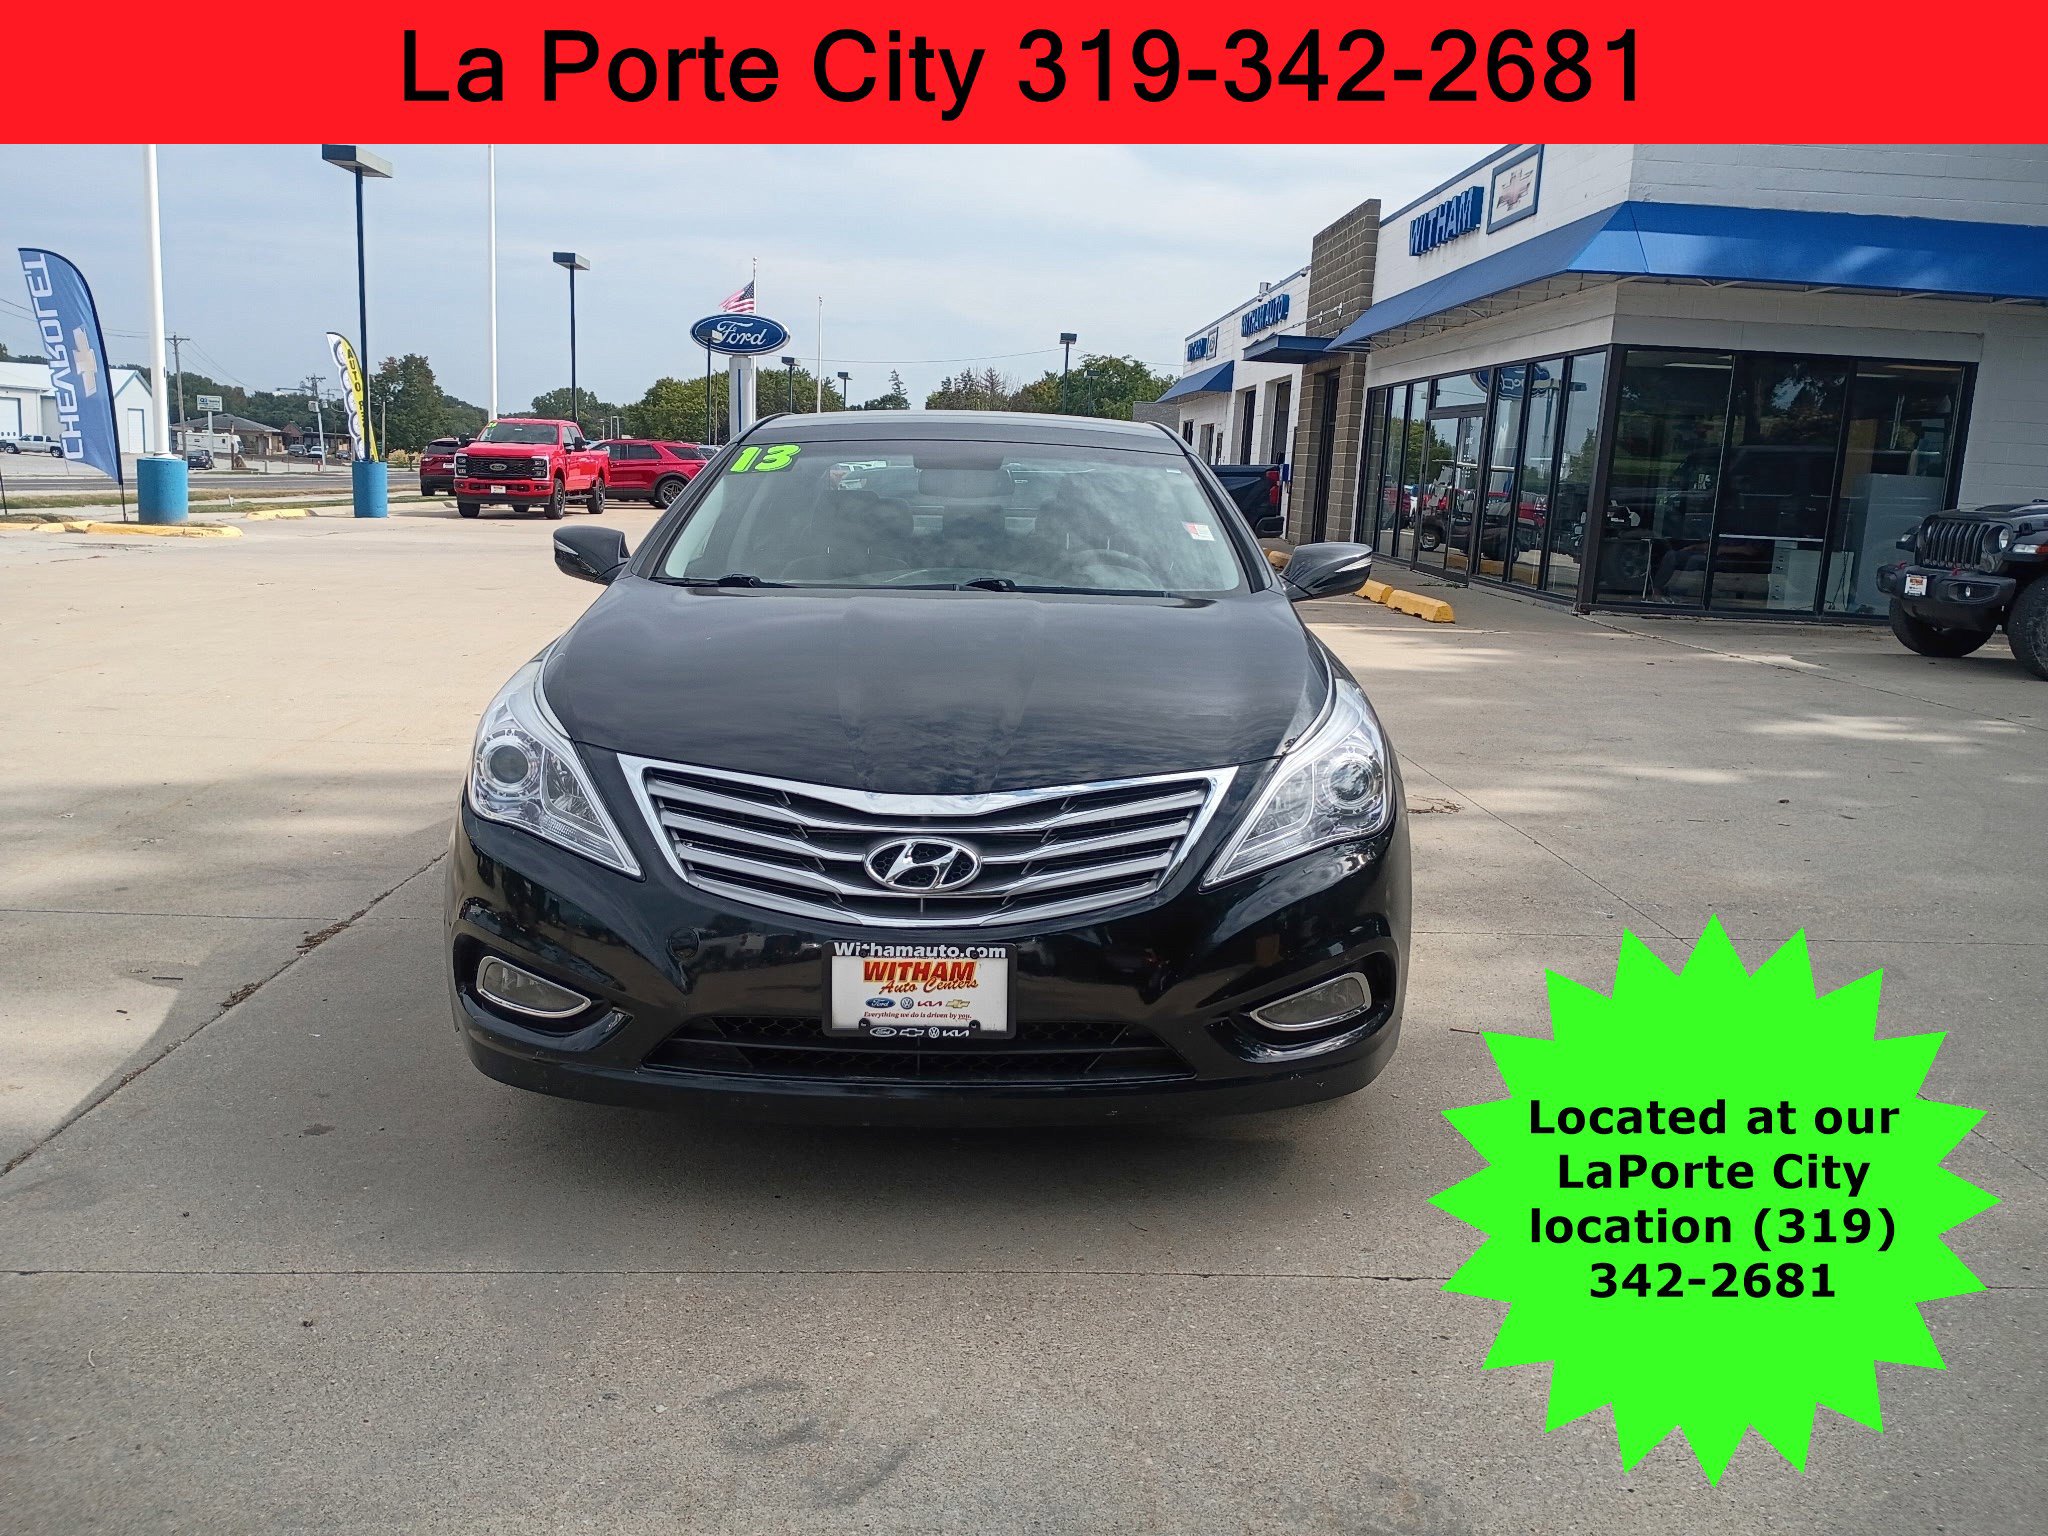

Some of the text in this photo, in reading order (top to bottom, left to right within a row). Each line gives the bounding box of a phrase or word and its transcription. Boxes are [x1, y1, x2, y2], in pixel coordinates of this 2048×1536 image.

[1409, 186, 1484, 256] WITHAM
[715, 320, 768, 345] Ford
[24, 253, 84, 460] CHEVROLET
[347, 349, 362, 392] AUTO
[730, 444, 802, 473] 13
[834, 942, 1006, 959] Withamauto.com
[864, 961, 977, 982] WITHAM
[879, 976, 979, 994] Auto Centers
